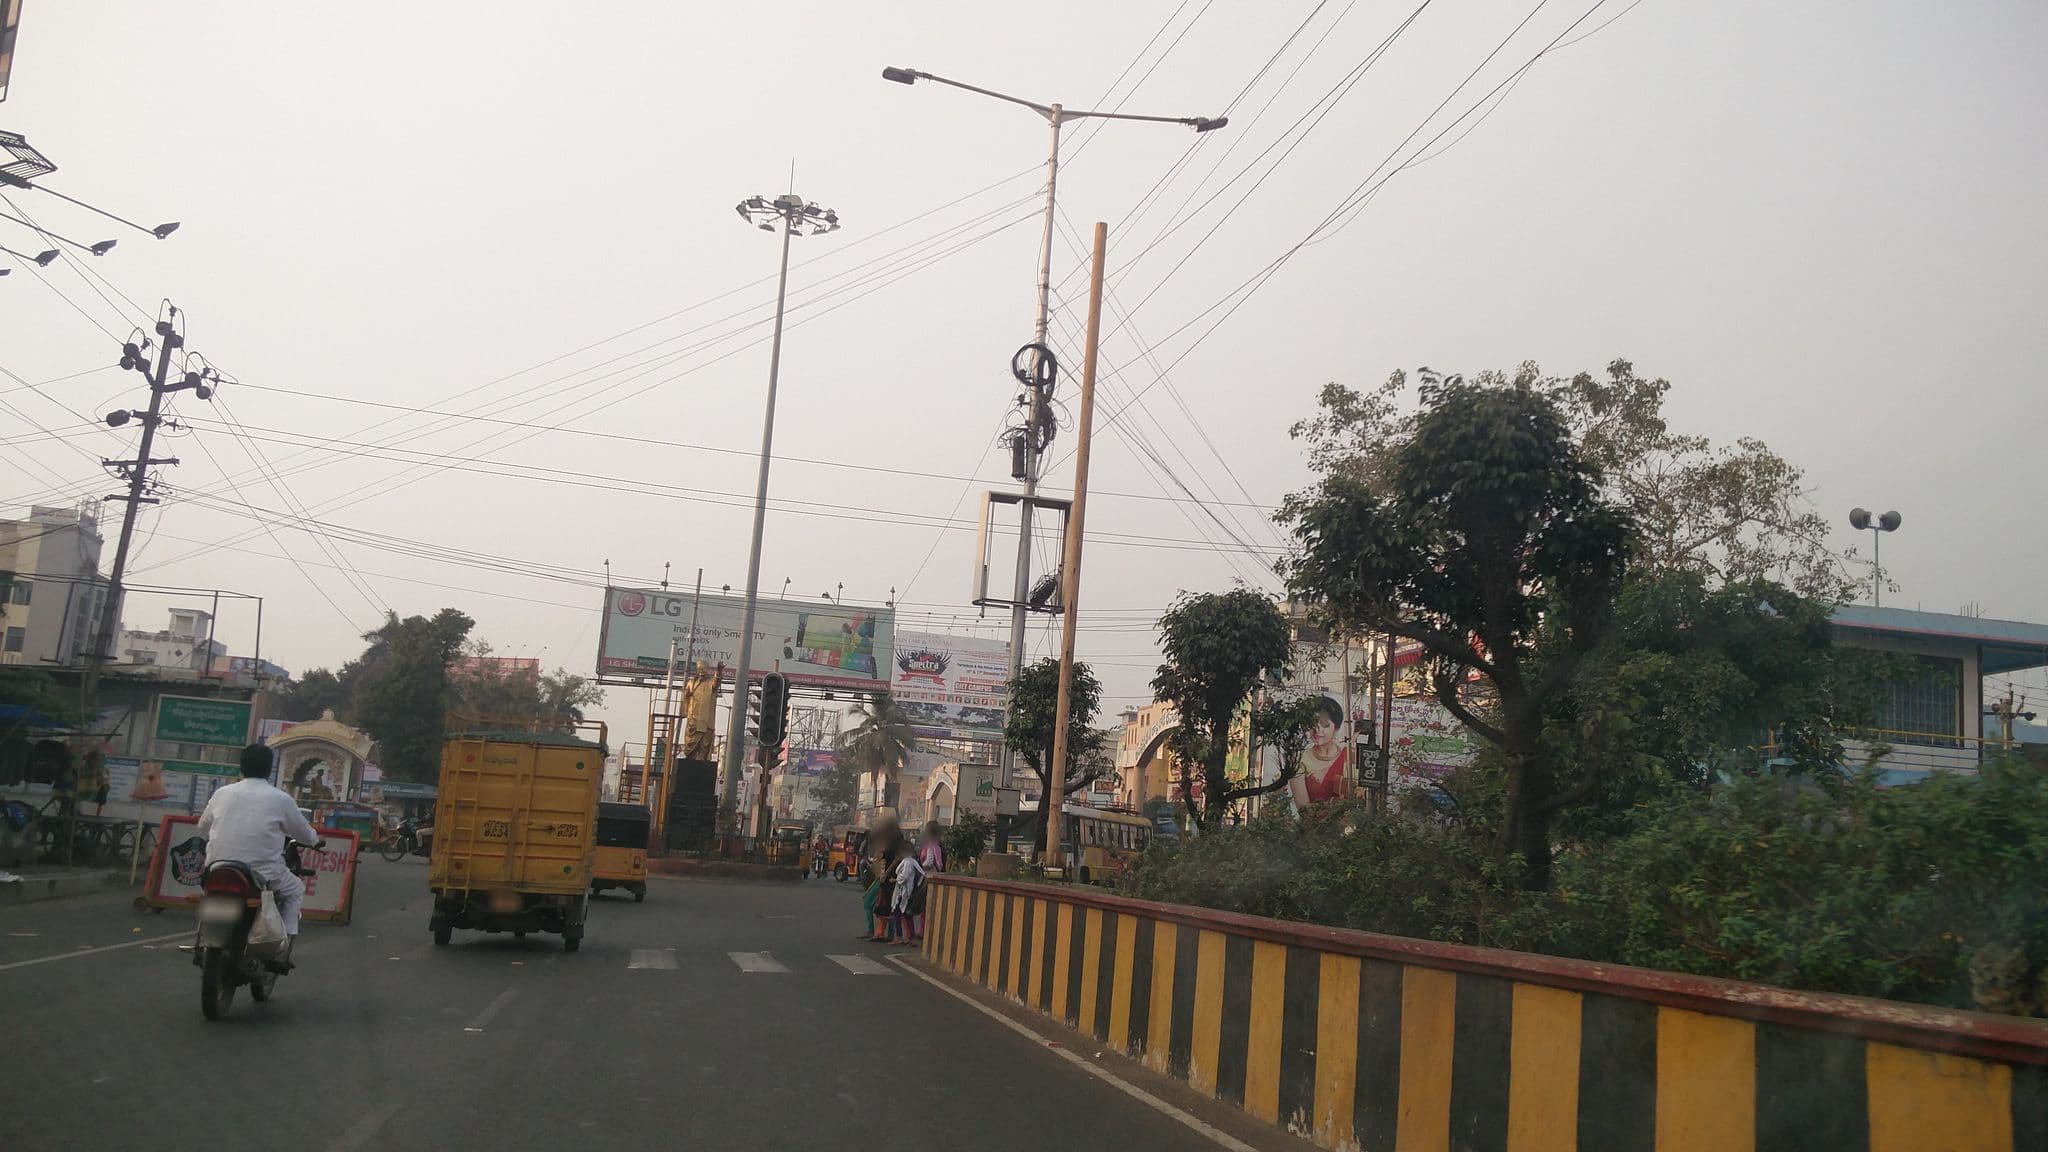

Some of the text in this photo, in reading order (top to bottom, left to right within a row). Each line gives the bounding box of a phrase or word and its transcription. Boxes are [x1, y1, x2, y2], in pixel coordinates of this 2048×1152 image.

[650, 595, 682, 617] LG
[703, 627, 722, 639] only
[753, 631, 766, 641] TV
[719, 651, 732, 660] TV
[297, 847, 348, 872] RADESH
